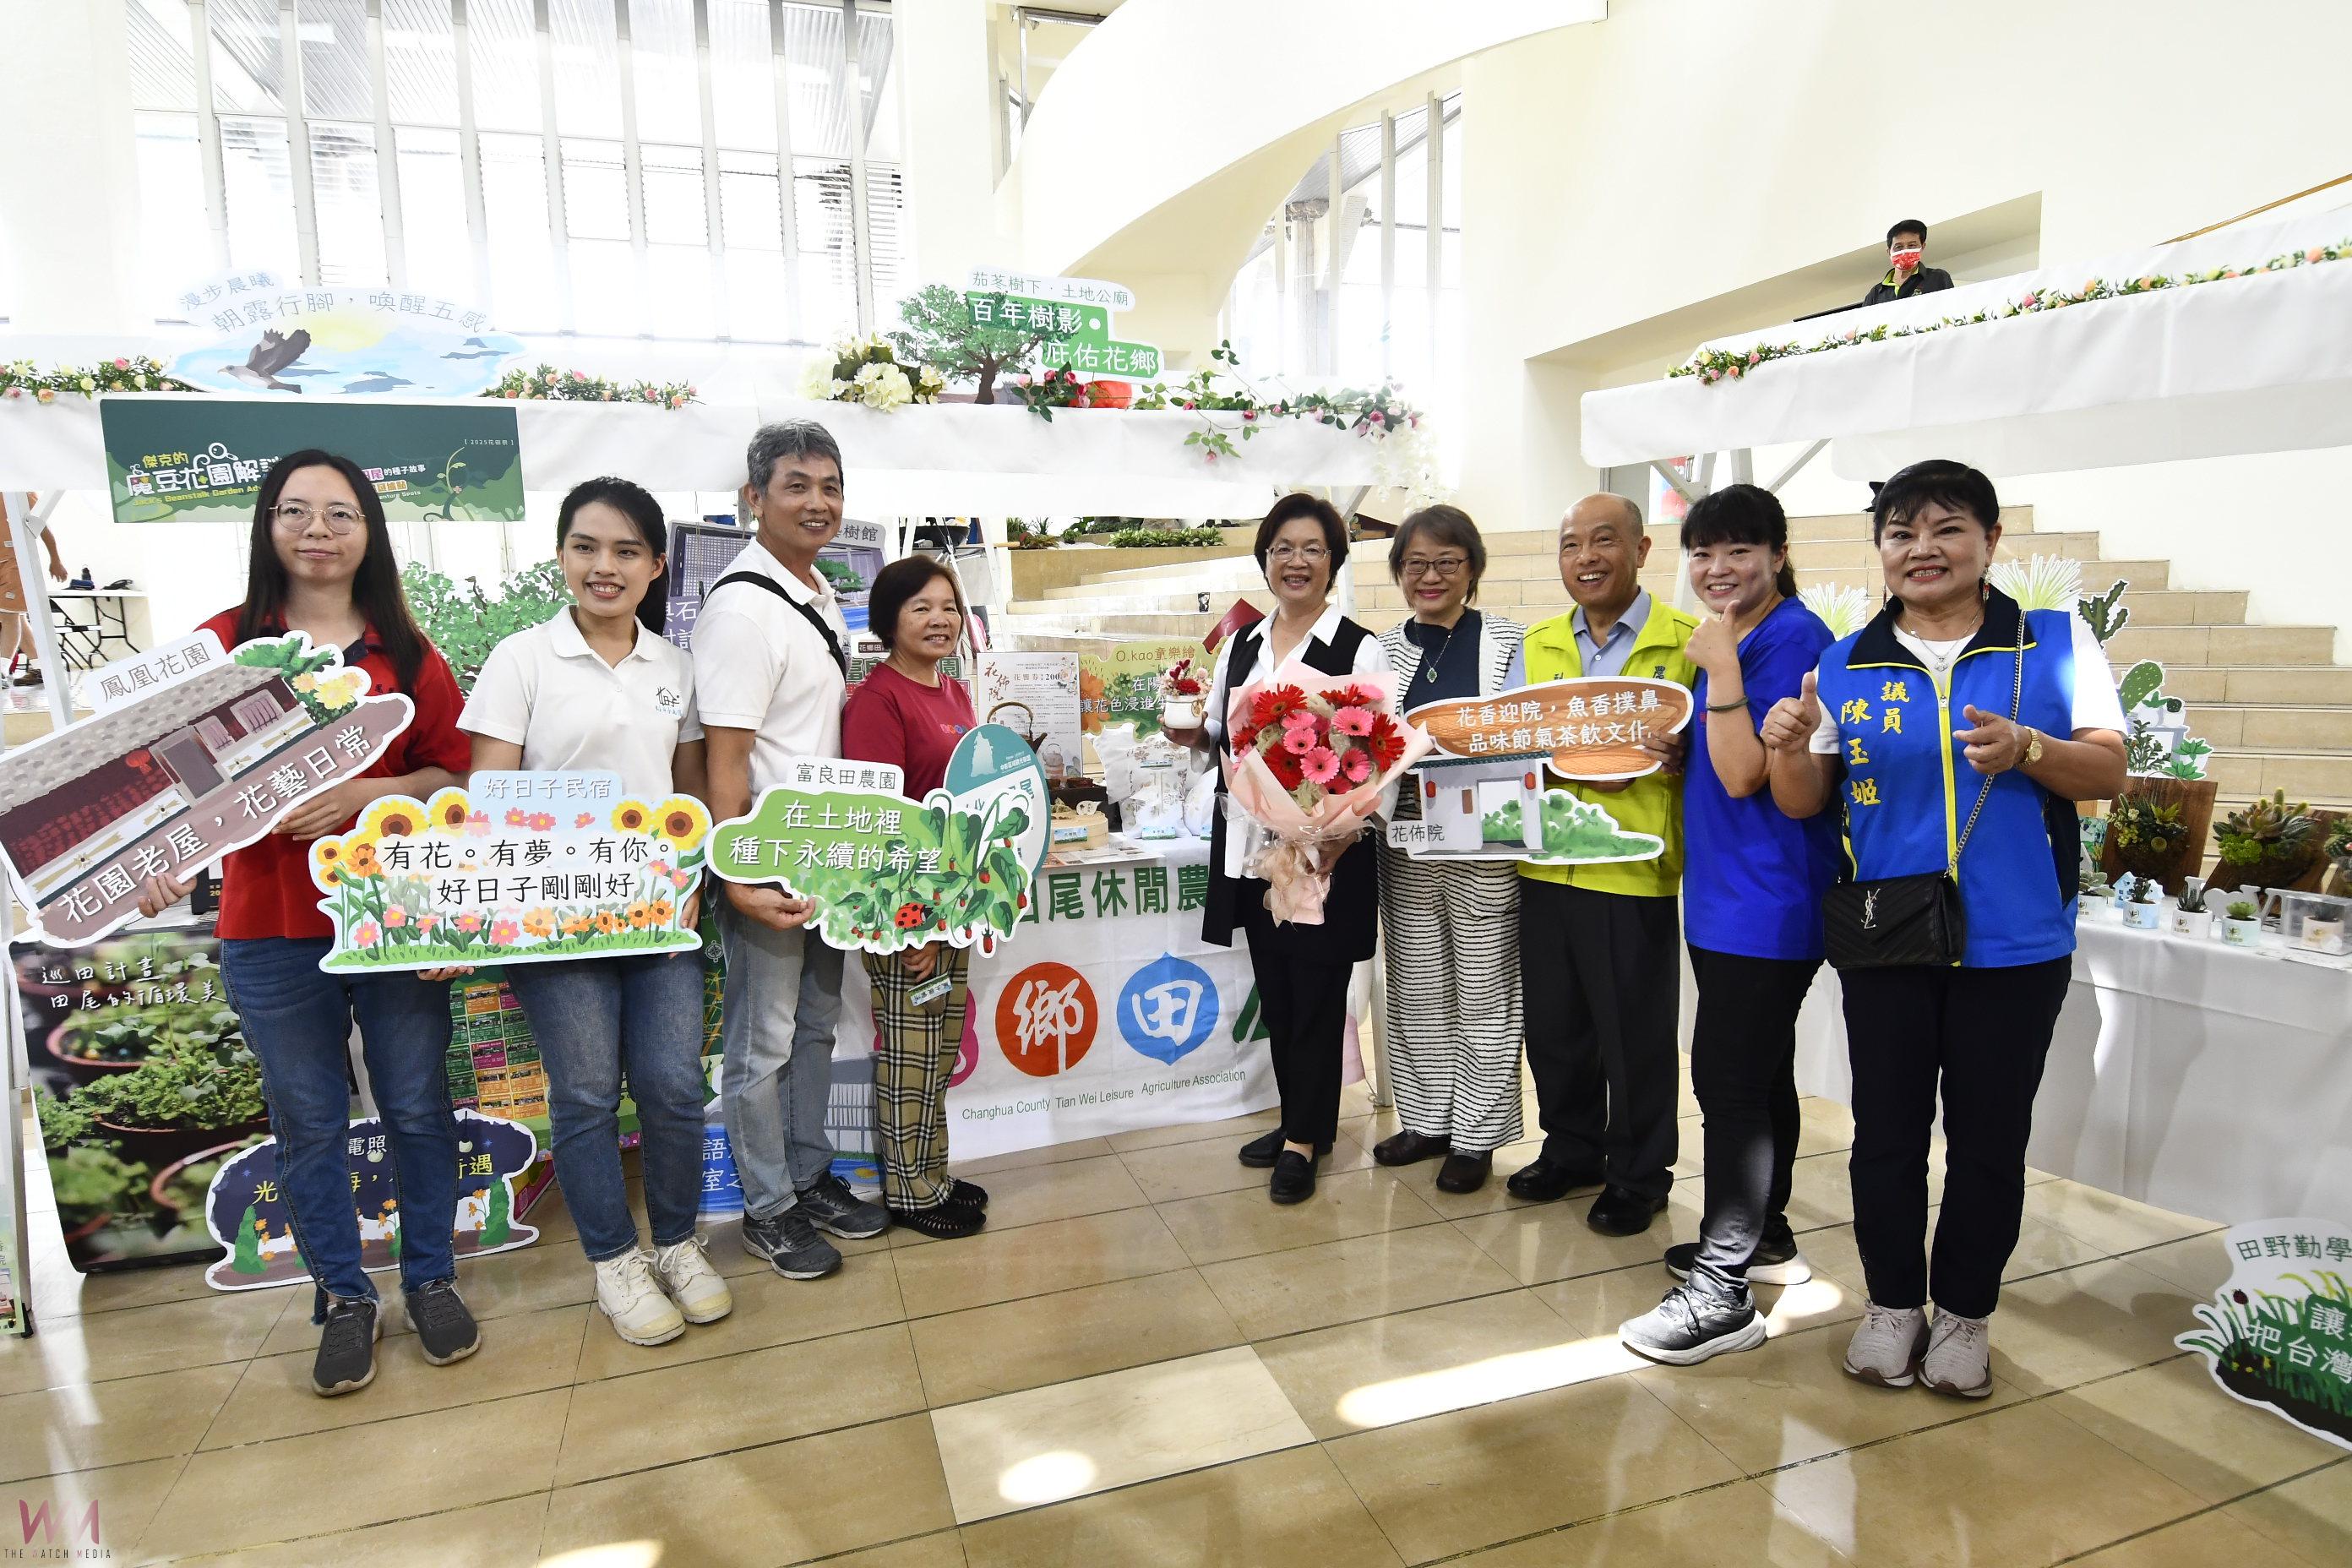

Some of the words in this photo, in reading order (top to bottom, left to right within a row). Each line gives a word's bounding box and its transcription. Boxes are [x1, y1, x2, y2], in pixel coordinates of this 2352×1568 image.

[180, 271, 275, 311] 漫步晨曦
[1045, 340, 1158, 375] 庇佑花鄉
[142, 451, 190, 469] 傑克的
[165, 490, 210, 503] Beanstalk
[212, 487, 244, 497] Garden
[100, 642, 211, 703] 鳳凰花園
[1881, 681, 1910, 734] 議員
[1468, 720, 1652, 754] 品味節氣茶飲文化
[482, 776, 612, 799] 好日子民宿
[796, 763, 896, 790] 富良田農園
[781, 799, 902, 836] 在土地裡
[1391, 824, 1446, 843] 花佈院
[728, 834, 943, 875] 種下永續的希望
[436, 872, 636, 906] 好日子剛剛好
[962, 1105, 1014, 1120] Changhua
[1016, 1098, 1052, 1113] County
[1056, 1097, 1075, 1109] Tian
[1078, 1092, 1097, 1105] Wei
[1100, 1088, 1134, 1102] Leisure
[1141, 1079, 1191, 1096] Agriculture
[1192, 1069, 1246, 1086] Association
[2235, 1234, 2352, 1263] 田野勤學
[2246, 1319, 2352, 1385] 把台灣
